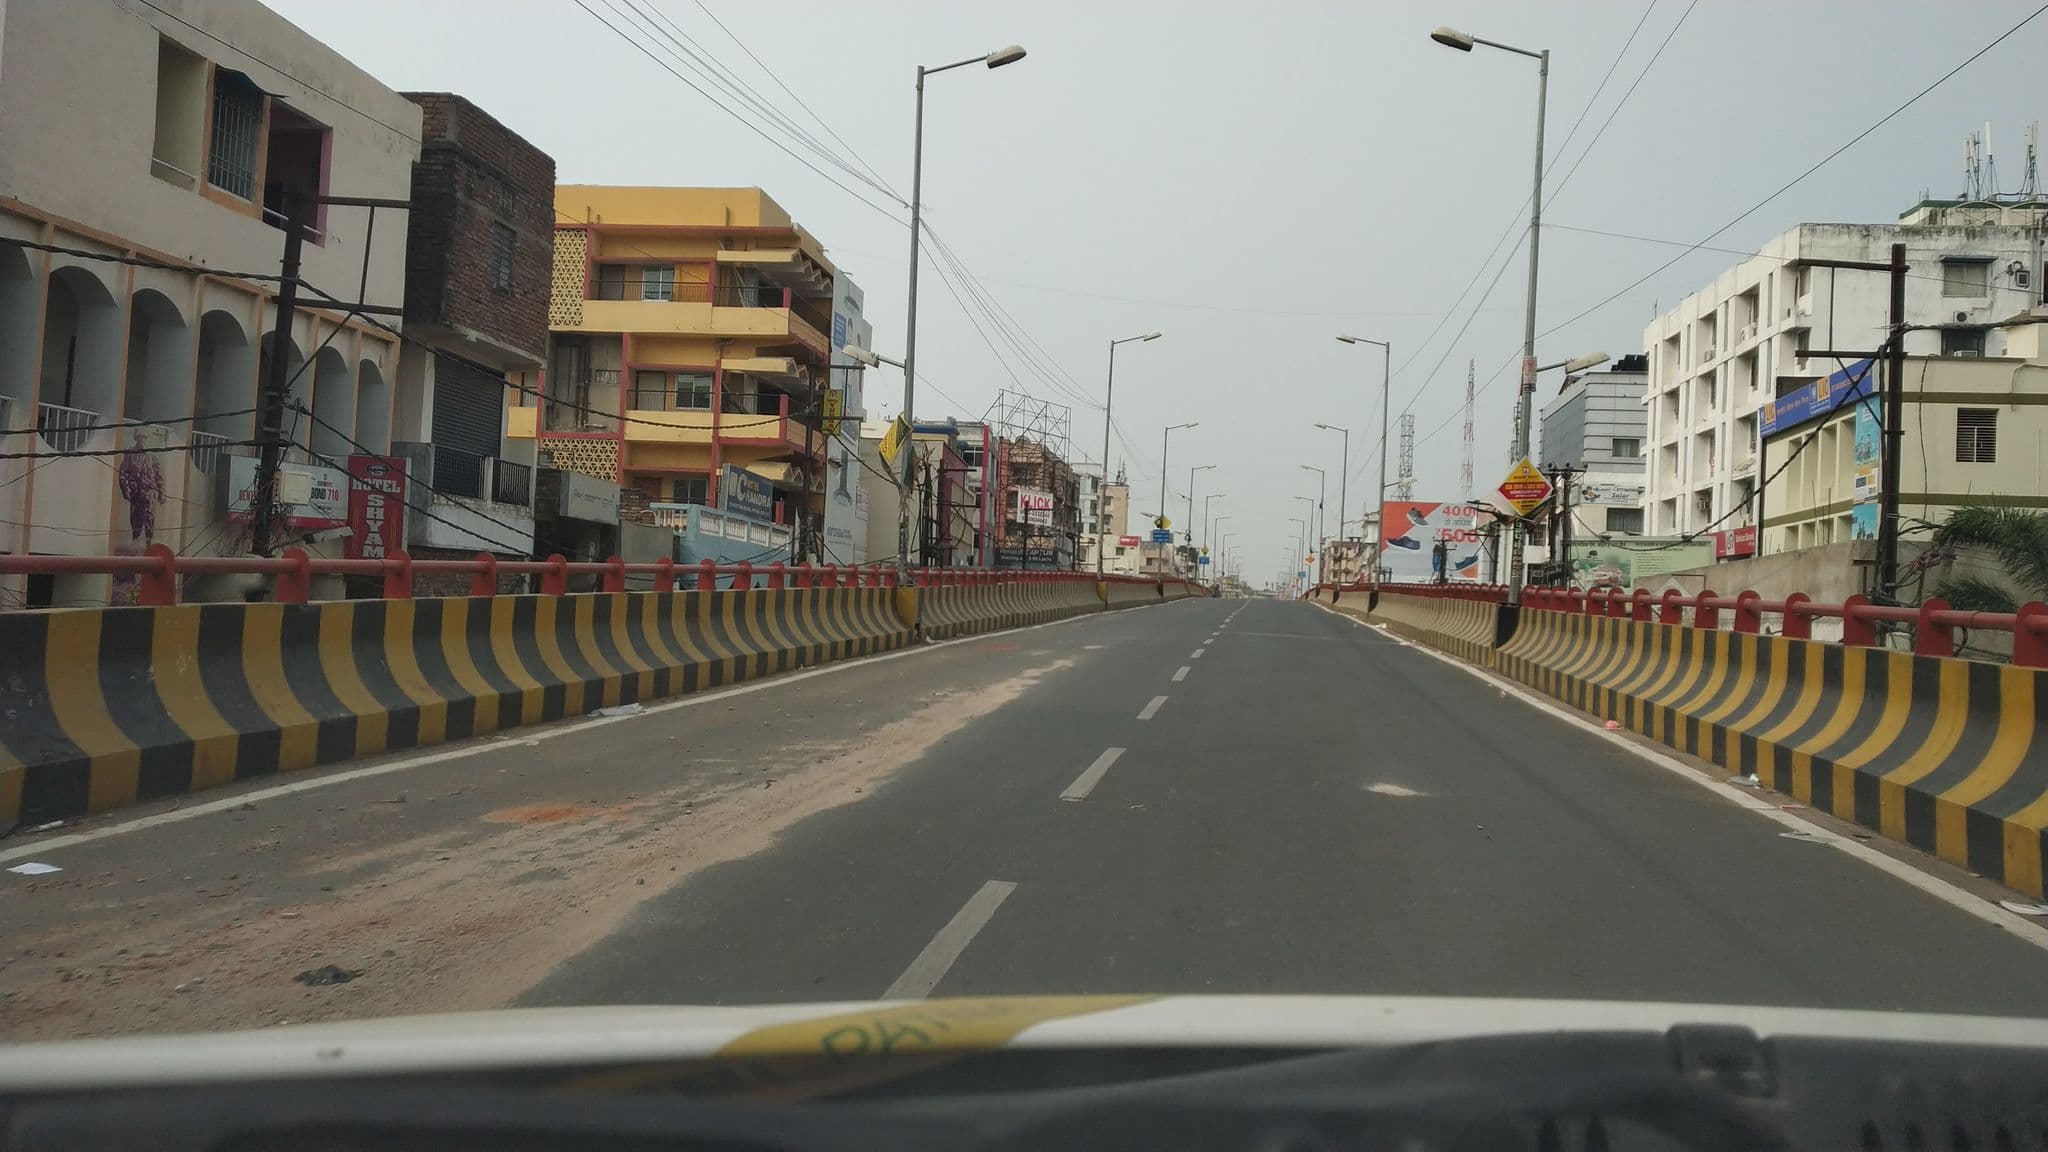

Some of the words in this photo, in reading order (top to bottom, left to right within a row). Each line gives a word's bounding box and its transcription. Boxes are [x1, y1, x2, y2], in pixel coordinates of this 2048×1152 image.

[352, 478, 400, 493] HOTEL
[328, 488, 339, 501] 710
[1020, 494, 1050, 509] KLICK
[362, 494, 384, 559] SHYAM
